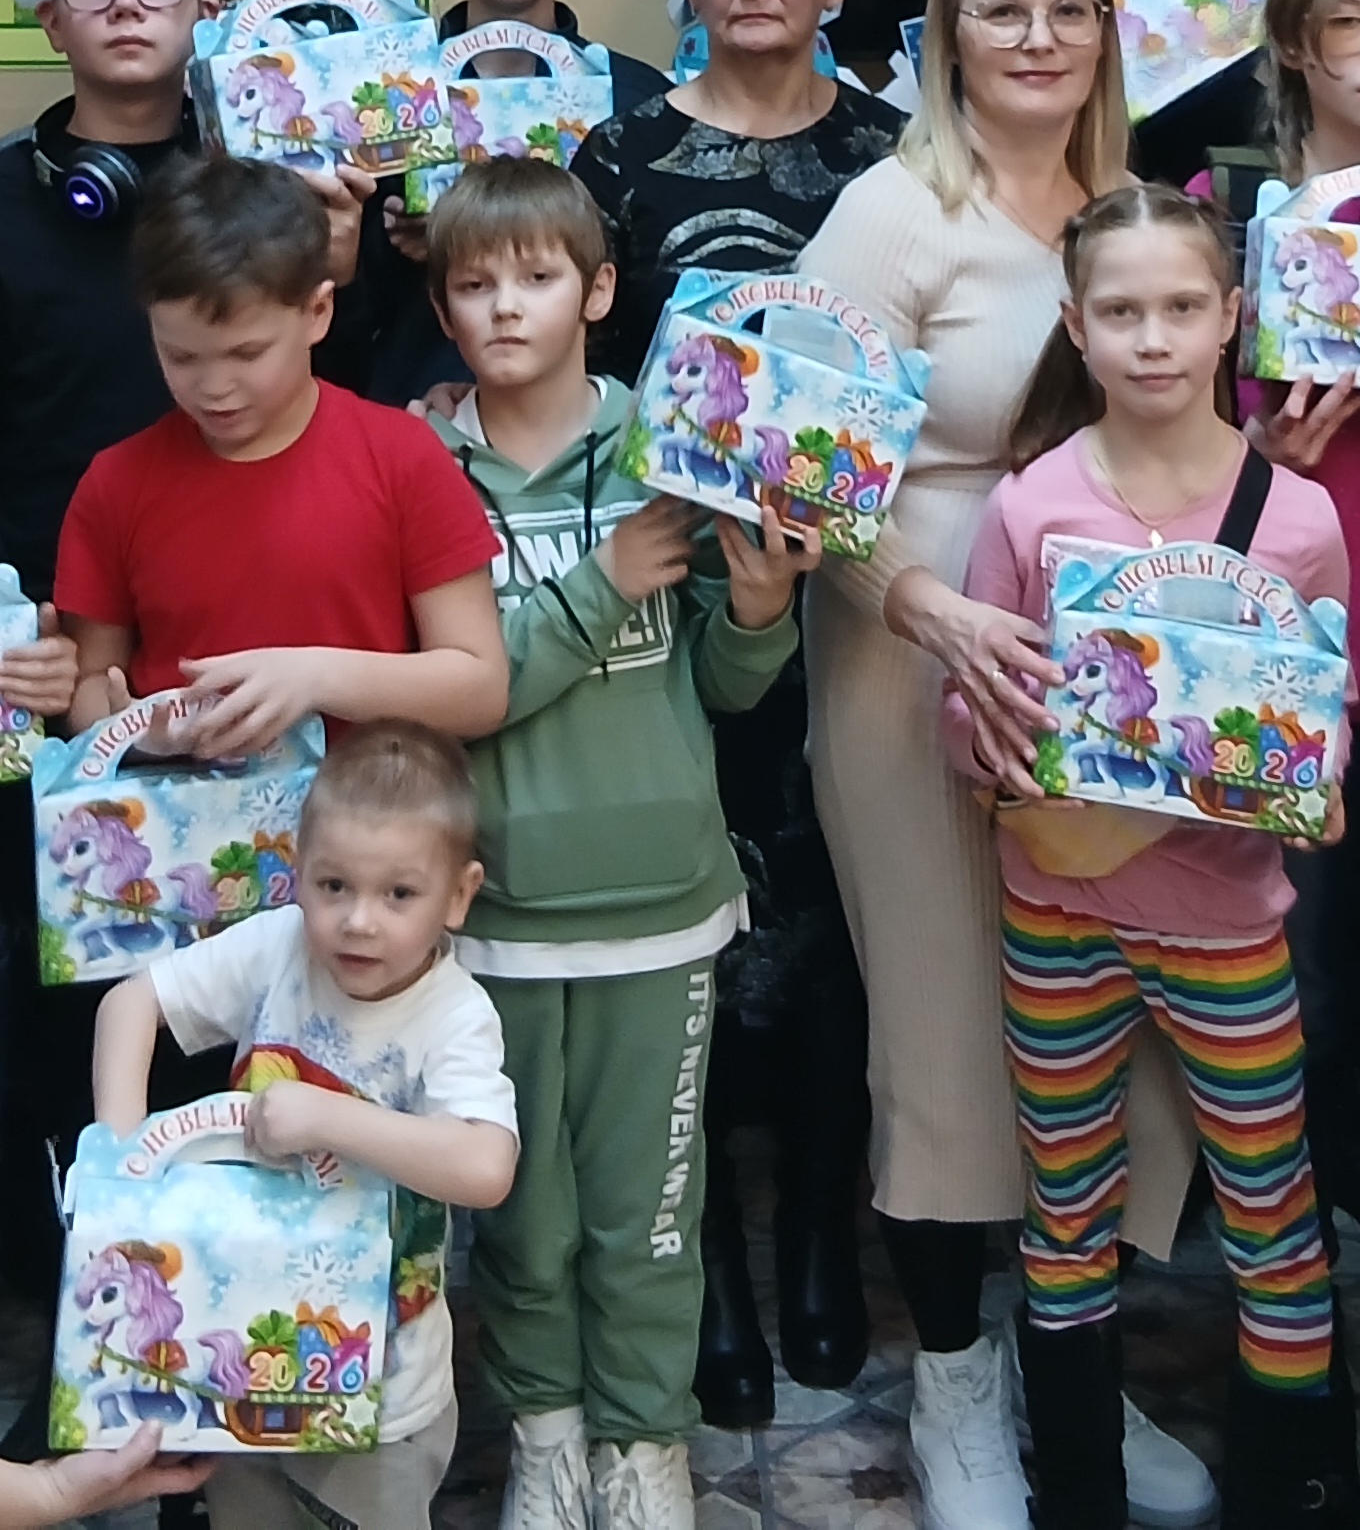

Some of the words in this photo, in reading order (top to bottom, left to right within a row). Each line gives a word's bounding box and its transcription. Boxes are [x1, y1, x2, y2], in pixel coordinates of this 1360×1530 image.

[232, 30, 248, 50] С
[515, 29, 576, 71] ГОДОМ
[358, 99, 440, 137] 2026
[713, 305, 734, 323] С
[730, 280, 824, 311] НОВЫМ
[783, 455, 878, 513] 2026
[1102, 590, 1125, 610] С
[1117, 552, 1214, 595] НОВЫМ
[81, 757, 104, 778] С
[1211, 737, 1319, 789] 2026
[215, 872, 291, 913] 202
[686, 971, 710, 1037] IT'S
[668, 1044, 703, 1161] NEVER
[126, 1153, 150, 1177] С
[142, 1102, 247, 1156] НОВЫМ
[650, 1162, 690, 1260] WEAR
[248, 1351, 366, 1394] 2026
